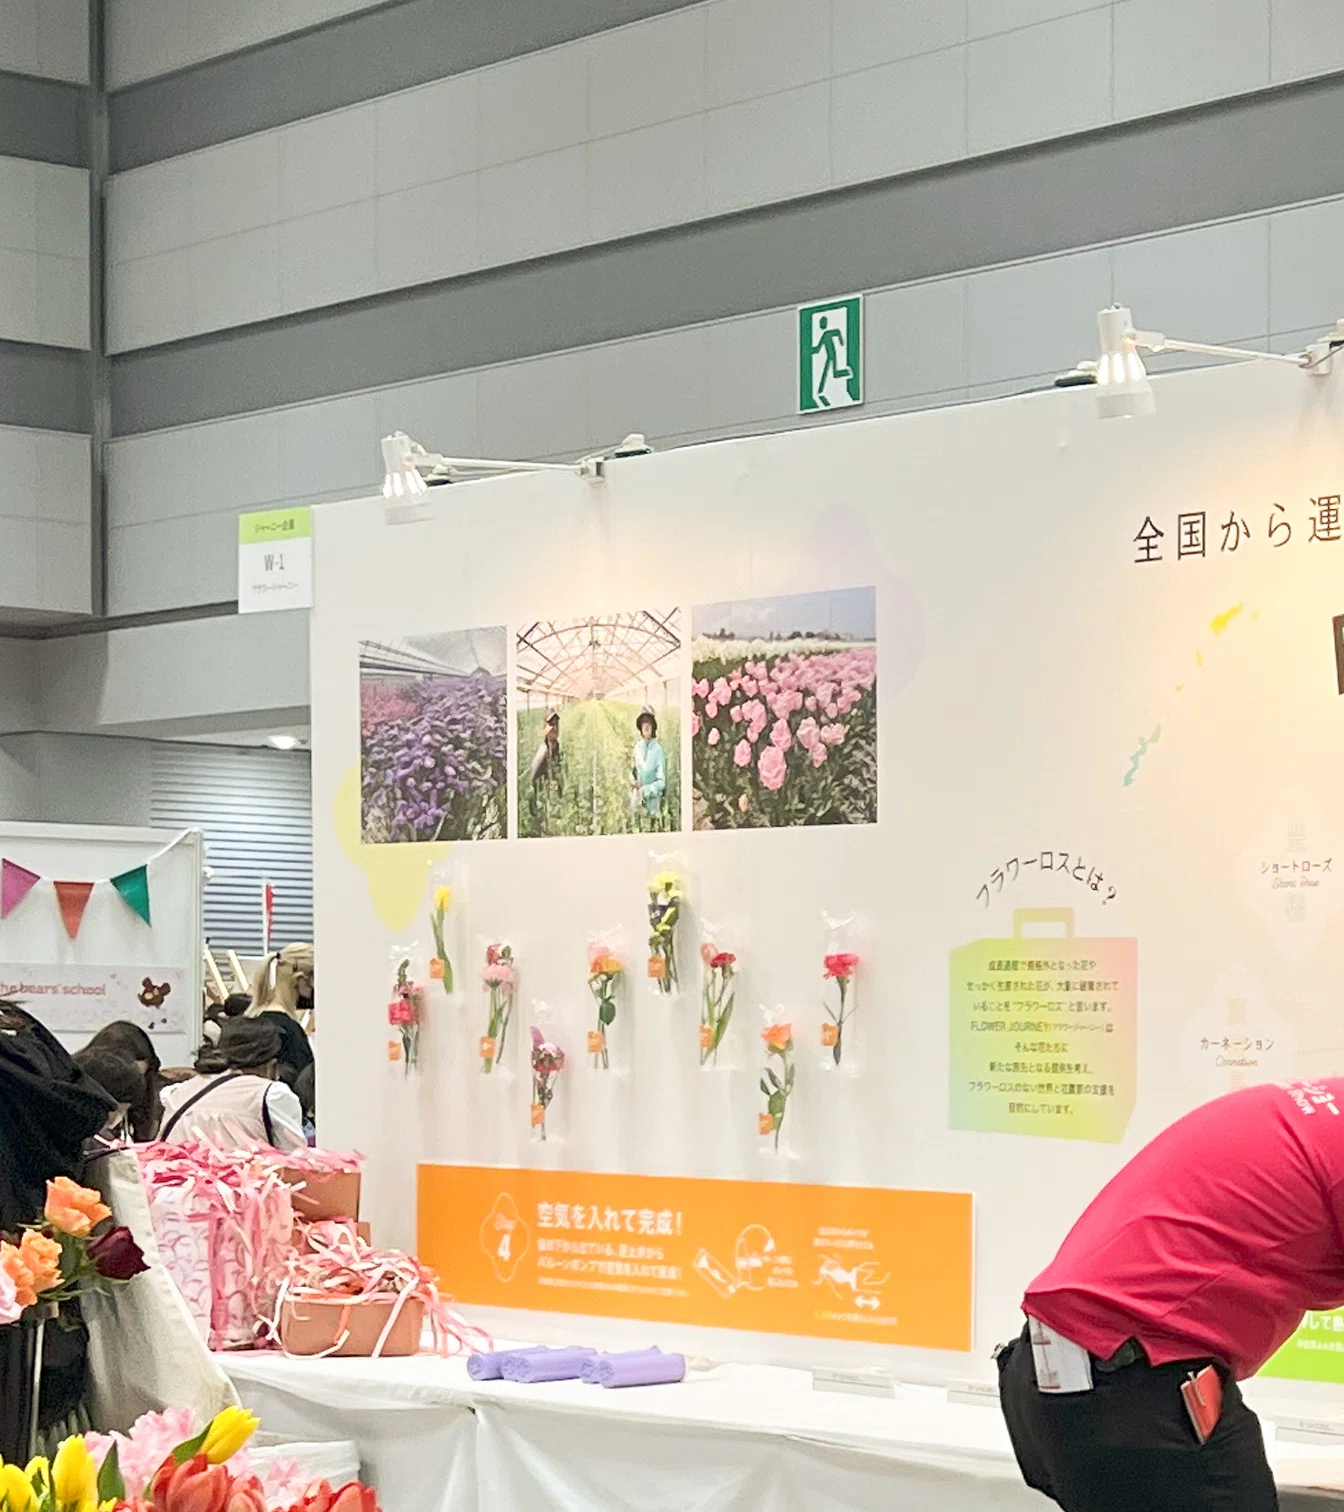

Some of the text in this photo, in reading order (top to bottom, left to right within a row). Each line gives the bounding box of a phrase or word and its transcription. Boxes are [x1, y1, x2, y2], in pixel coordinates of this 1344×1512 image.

[264, 553, 285, 571] W-1
[1261, 857, 1333, 875] ショートローズ
[62, 983, 106, 996] school
[1200, 1036, 1274, 1051] カーネーション
[497, 1233, 512, 1262] 4
